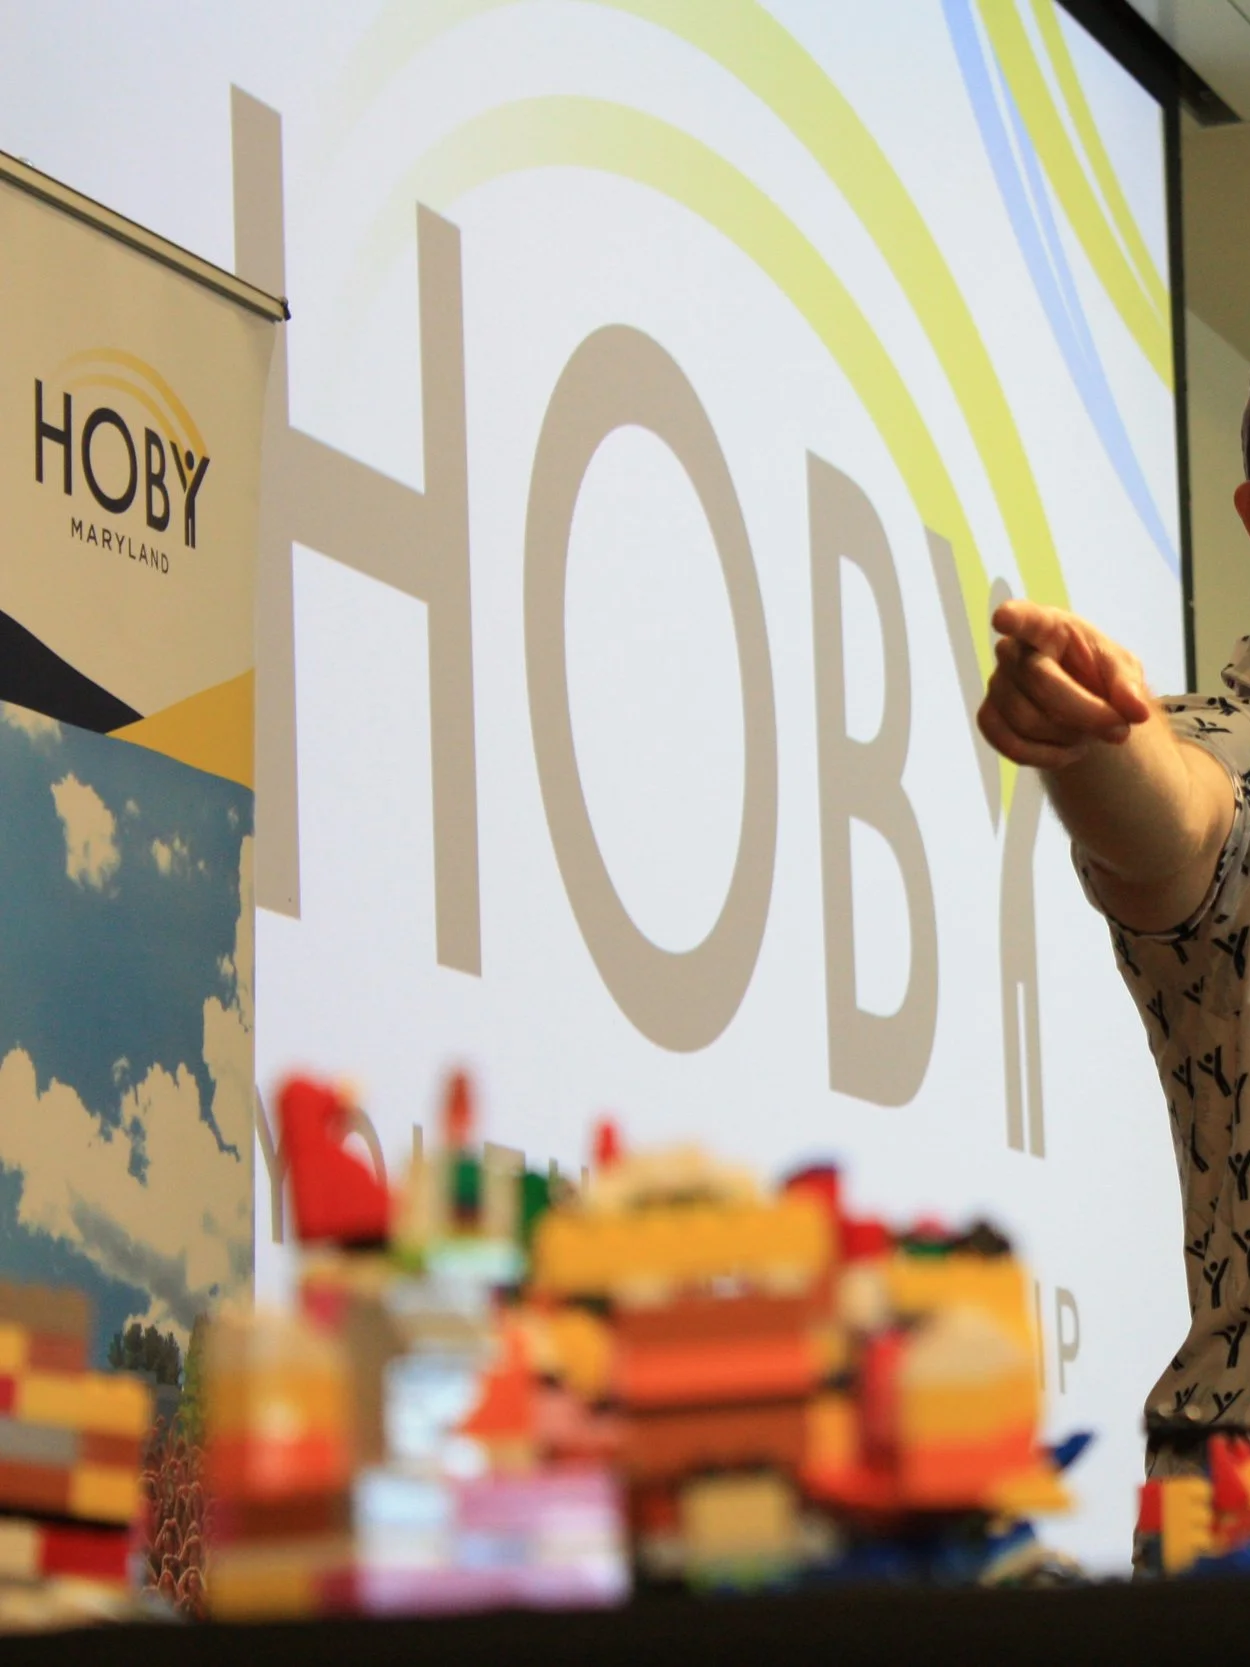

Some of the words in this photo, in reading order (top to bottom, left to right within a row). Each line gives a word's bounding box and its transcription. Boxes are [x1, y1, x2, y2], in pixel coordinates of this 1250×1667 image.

[34, 377, 210, 550] HOBY
[70, 516, 170, 575] MARYLAND
[229, 82, 1047, 1160] HOBY
